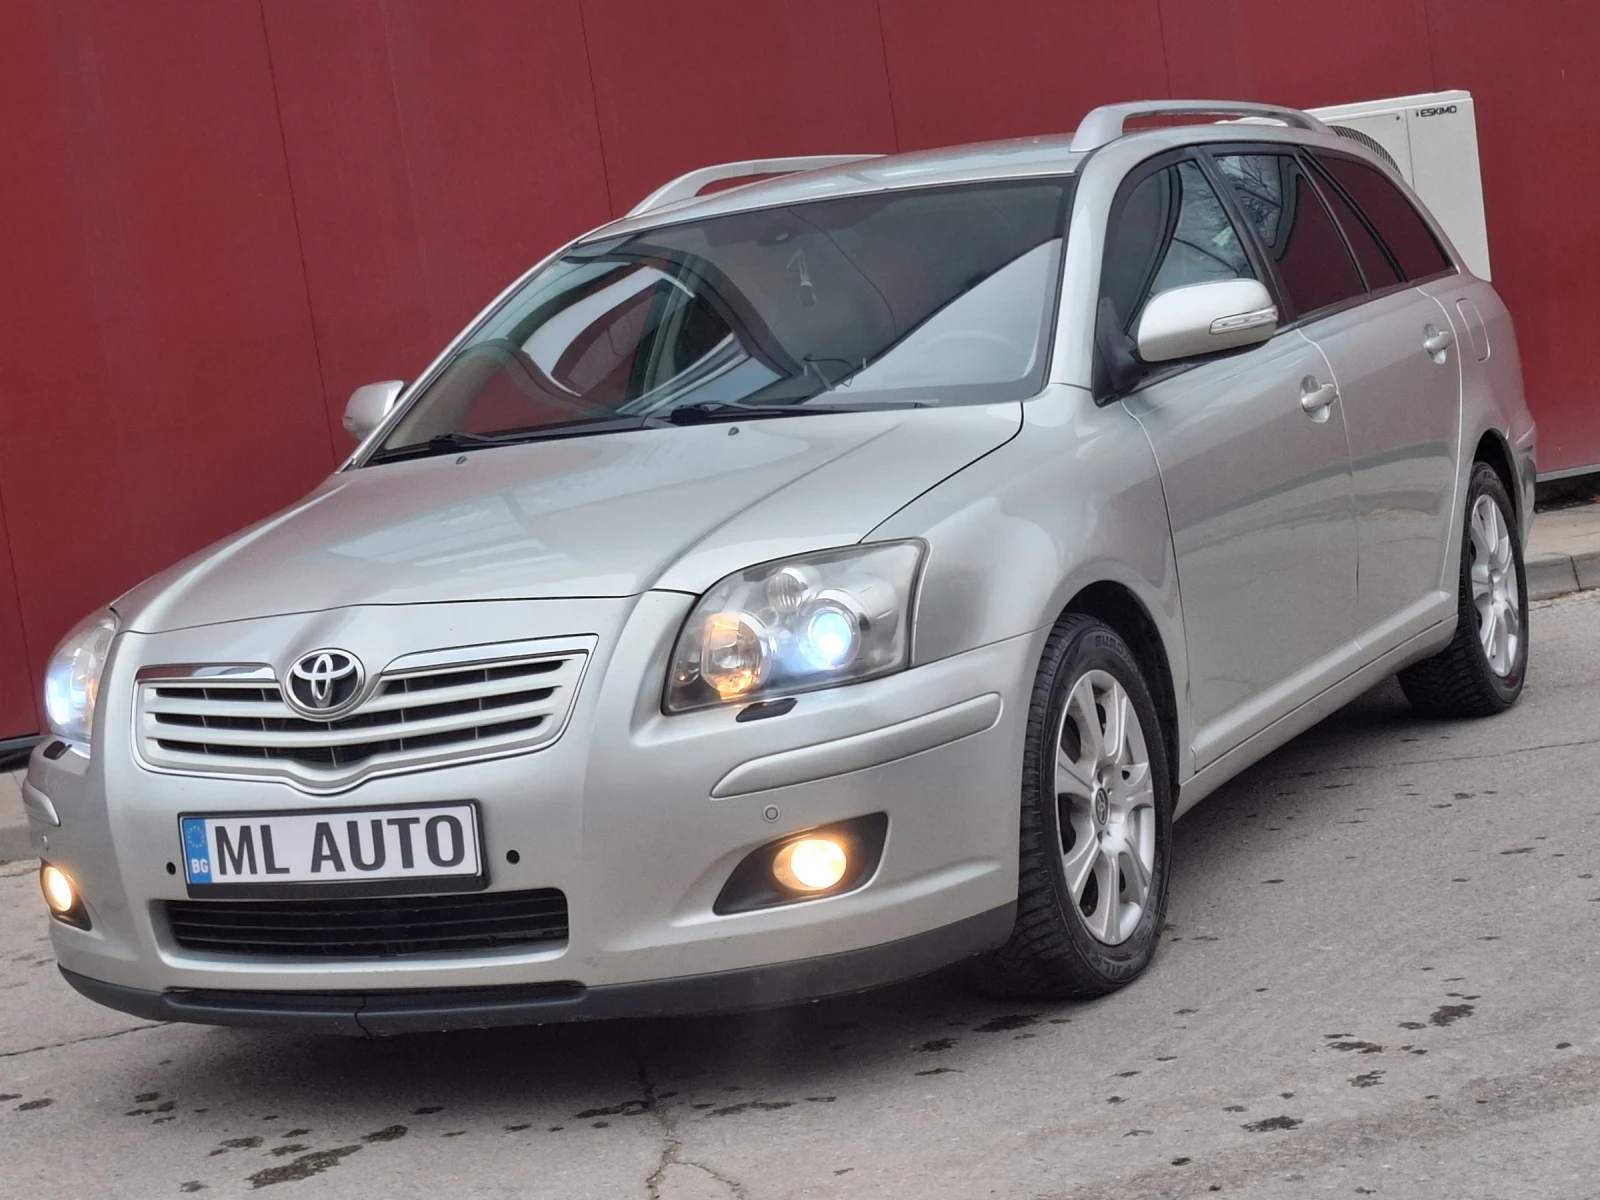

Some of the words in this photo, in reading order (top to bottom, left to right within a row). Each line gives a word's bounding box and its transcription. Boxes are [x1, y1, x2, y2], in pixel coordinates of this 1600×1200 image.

[1420, 105, 1457, 117] ESKIMO
[215, 824, 290, 875] ML
[310, 814, 465, 873] AUTO
[191, 858, 209, 873] BG
